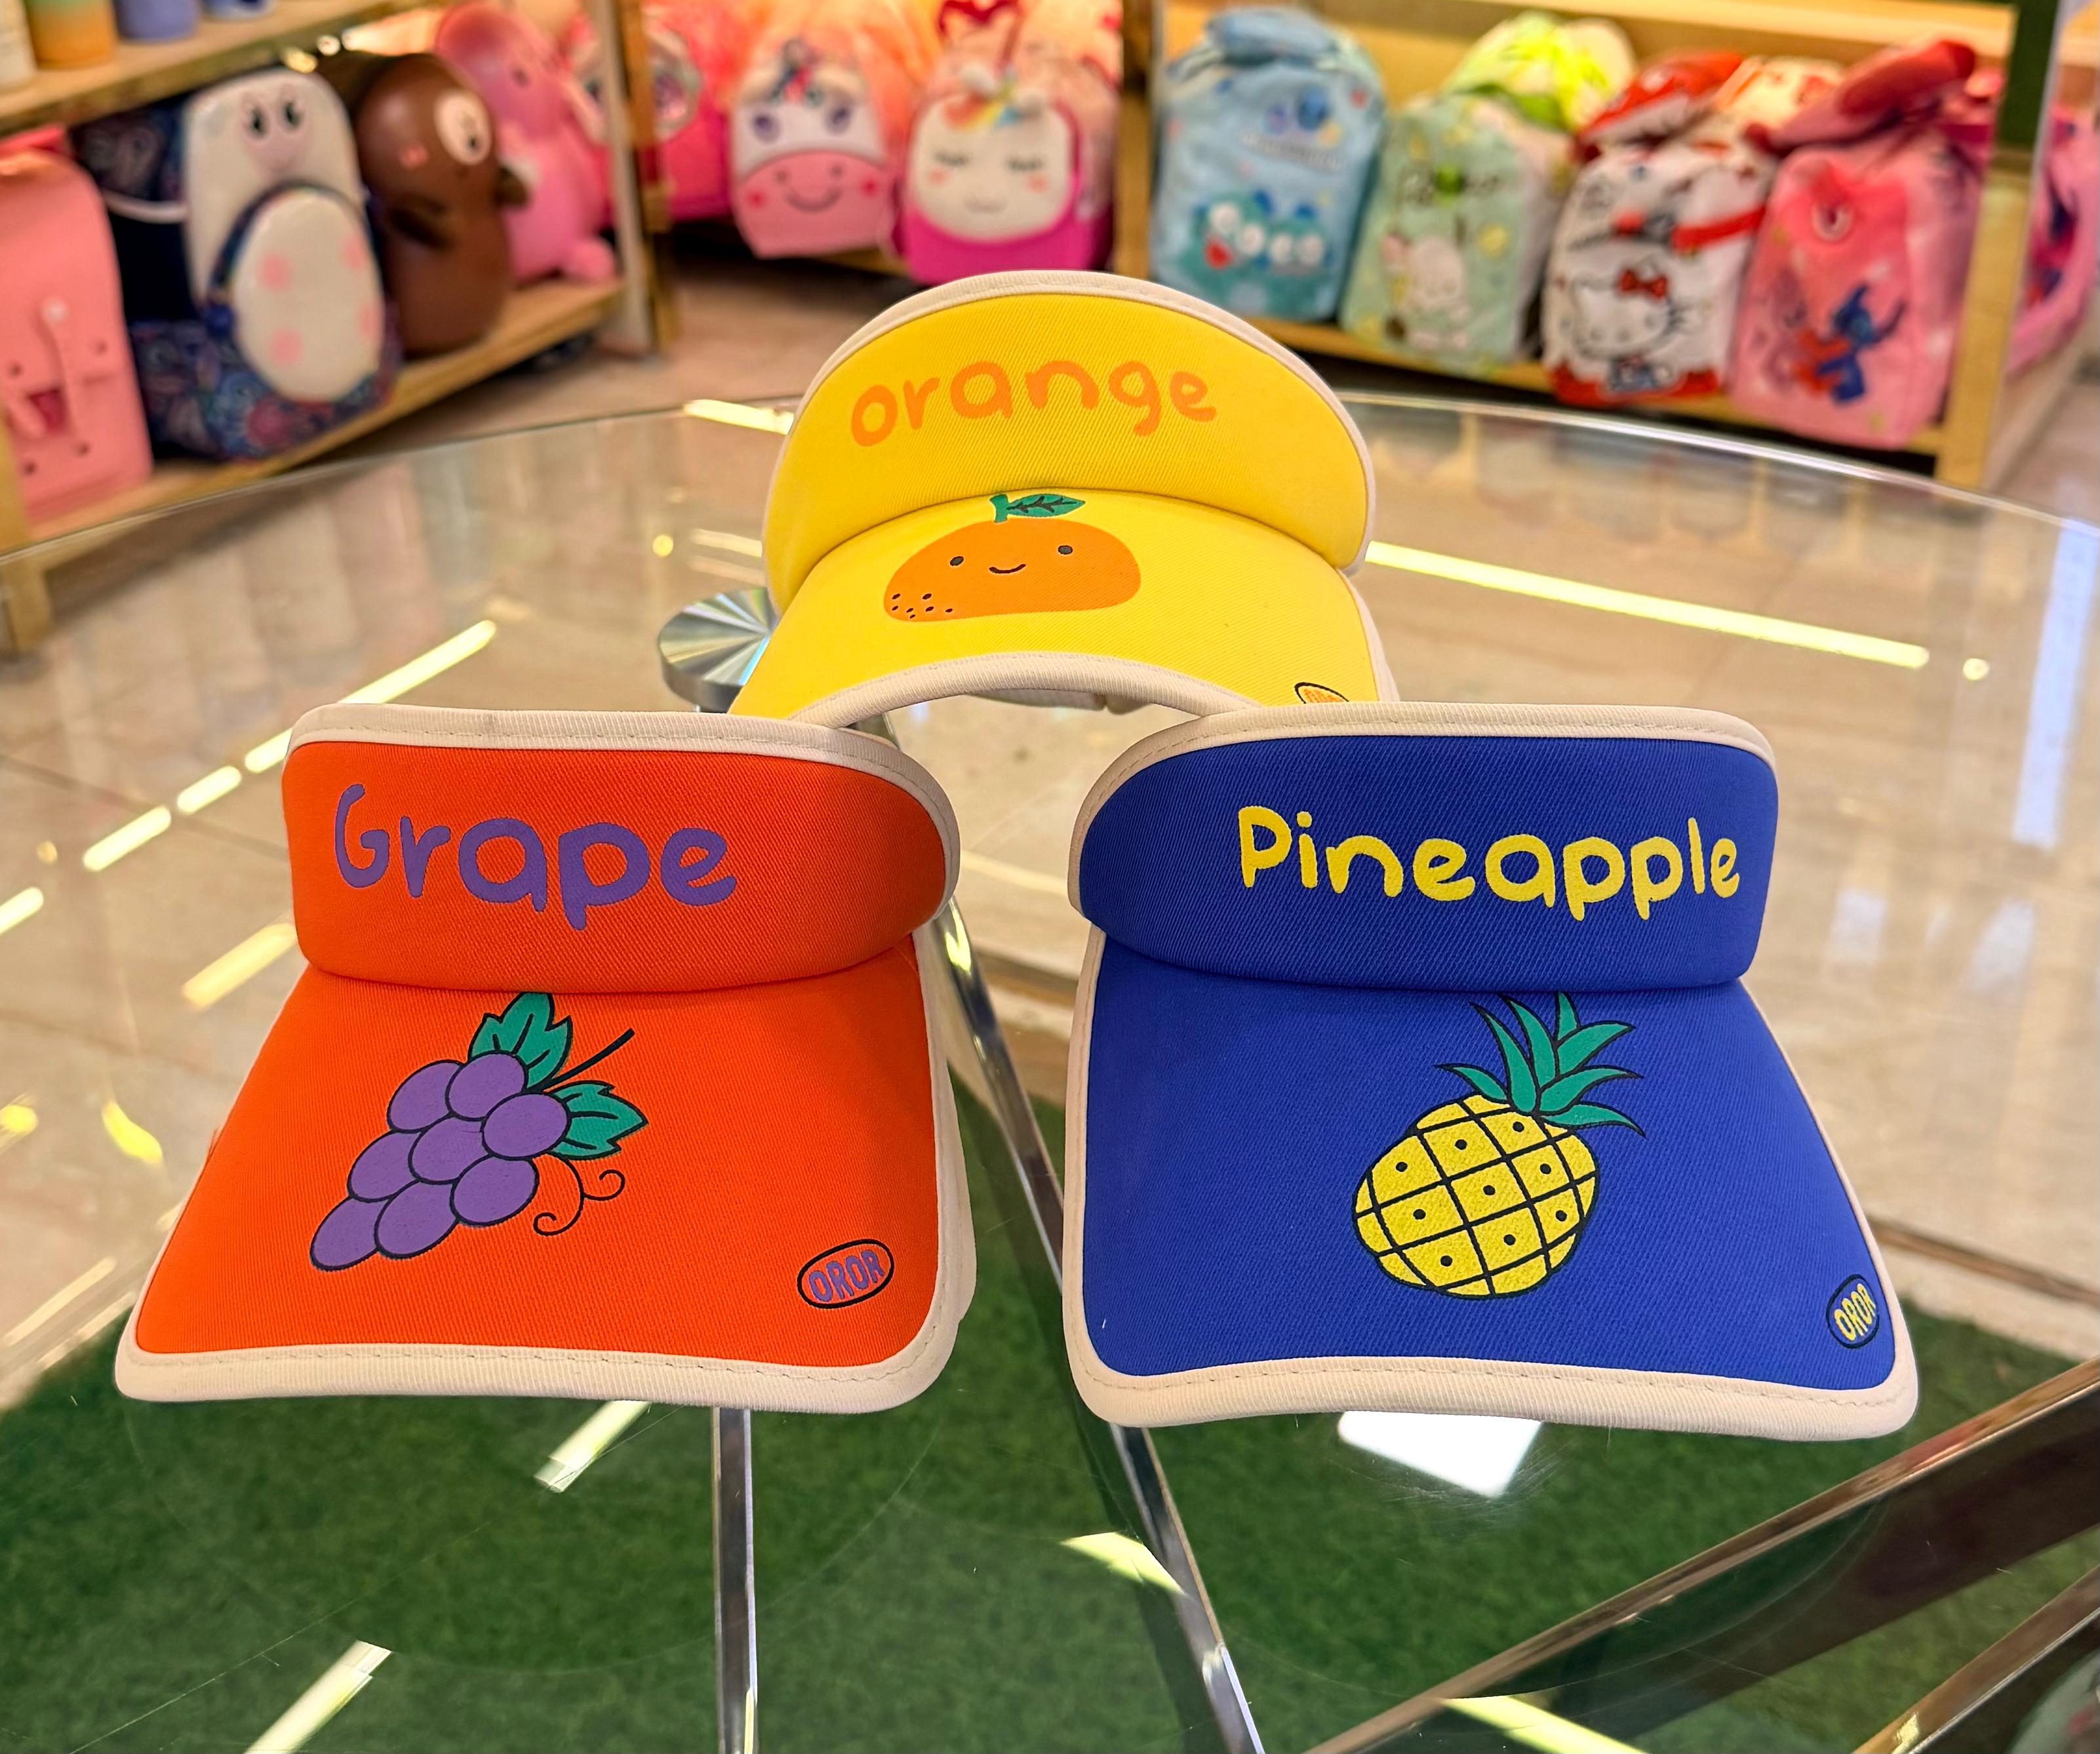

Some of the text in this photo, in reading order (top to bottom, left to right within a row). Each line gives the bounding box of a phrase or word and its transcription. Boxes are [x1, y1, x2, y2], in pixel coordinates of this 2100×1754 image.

[850, 359, 1218, 447] orange
[334, 784, 736, 930] Grape
[1238, 806, 1739, 921] Pineapple
[808, 1250, 884, 1302] OROR
[1834, 1283, 1876, 1341] OROR
